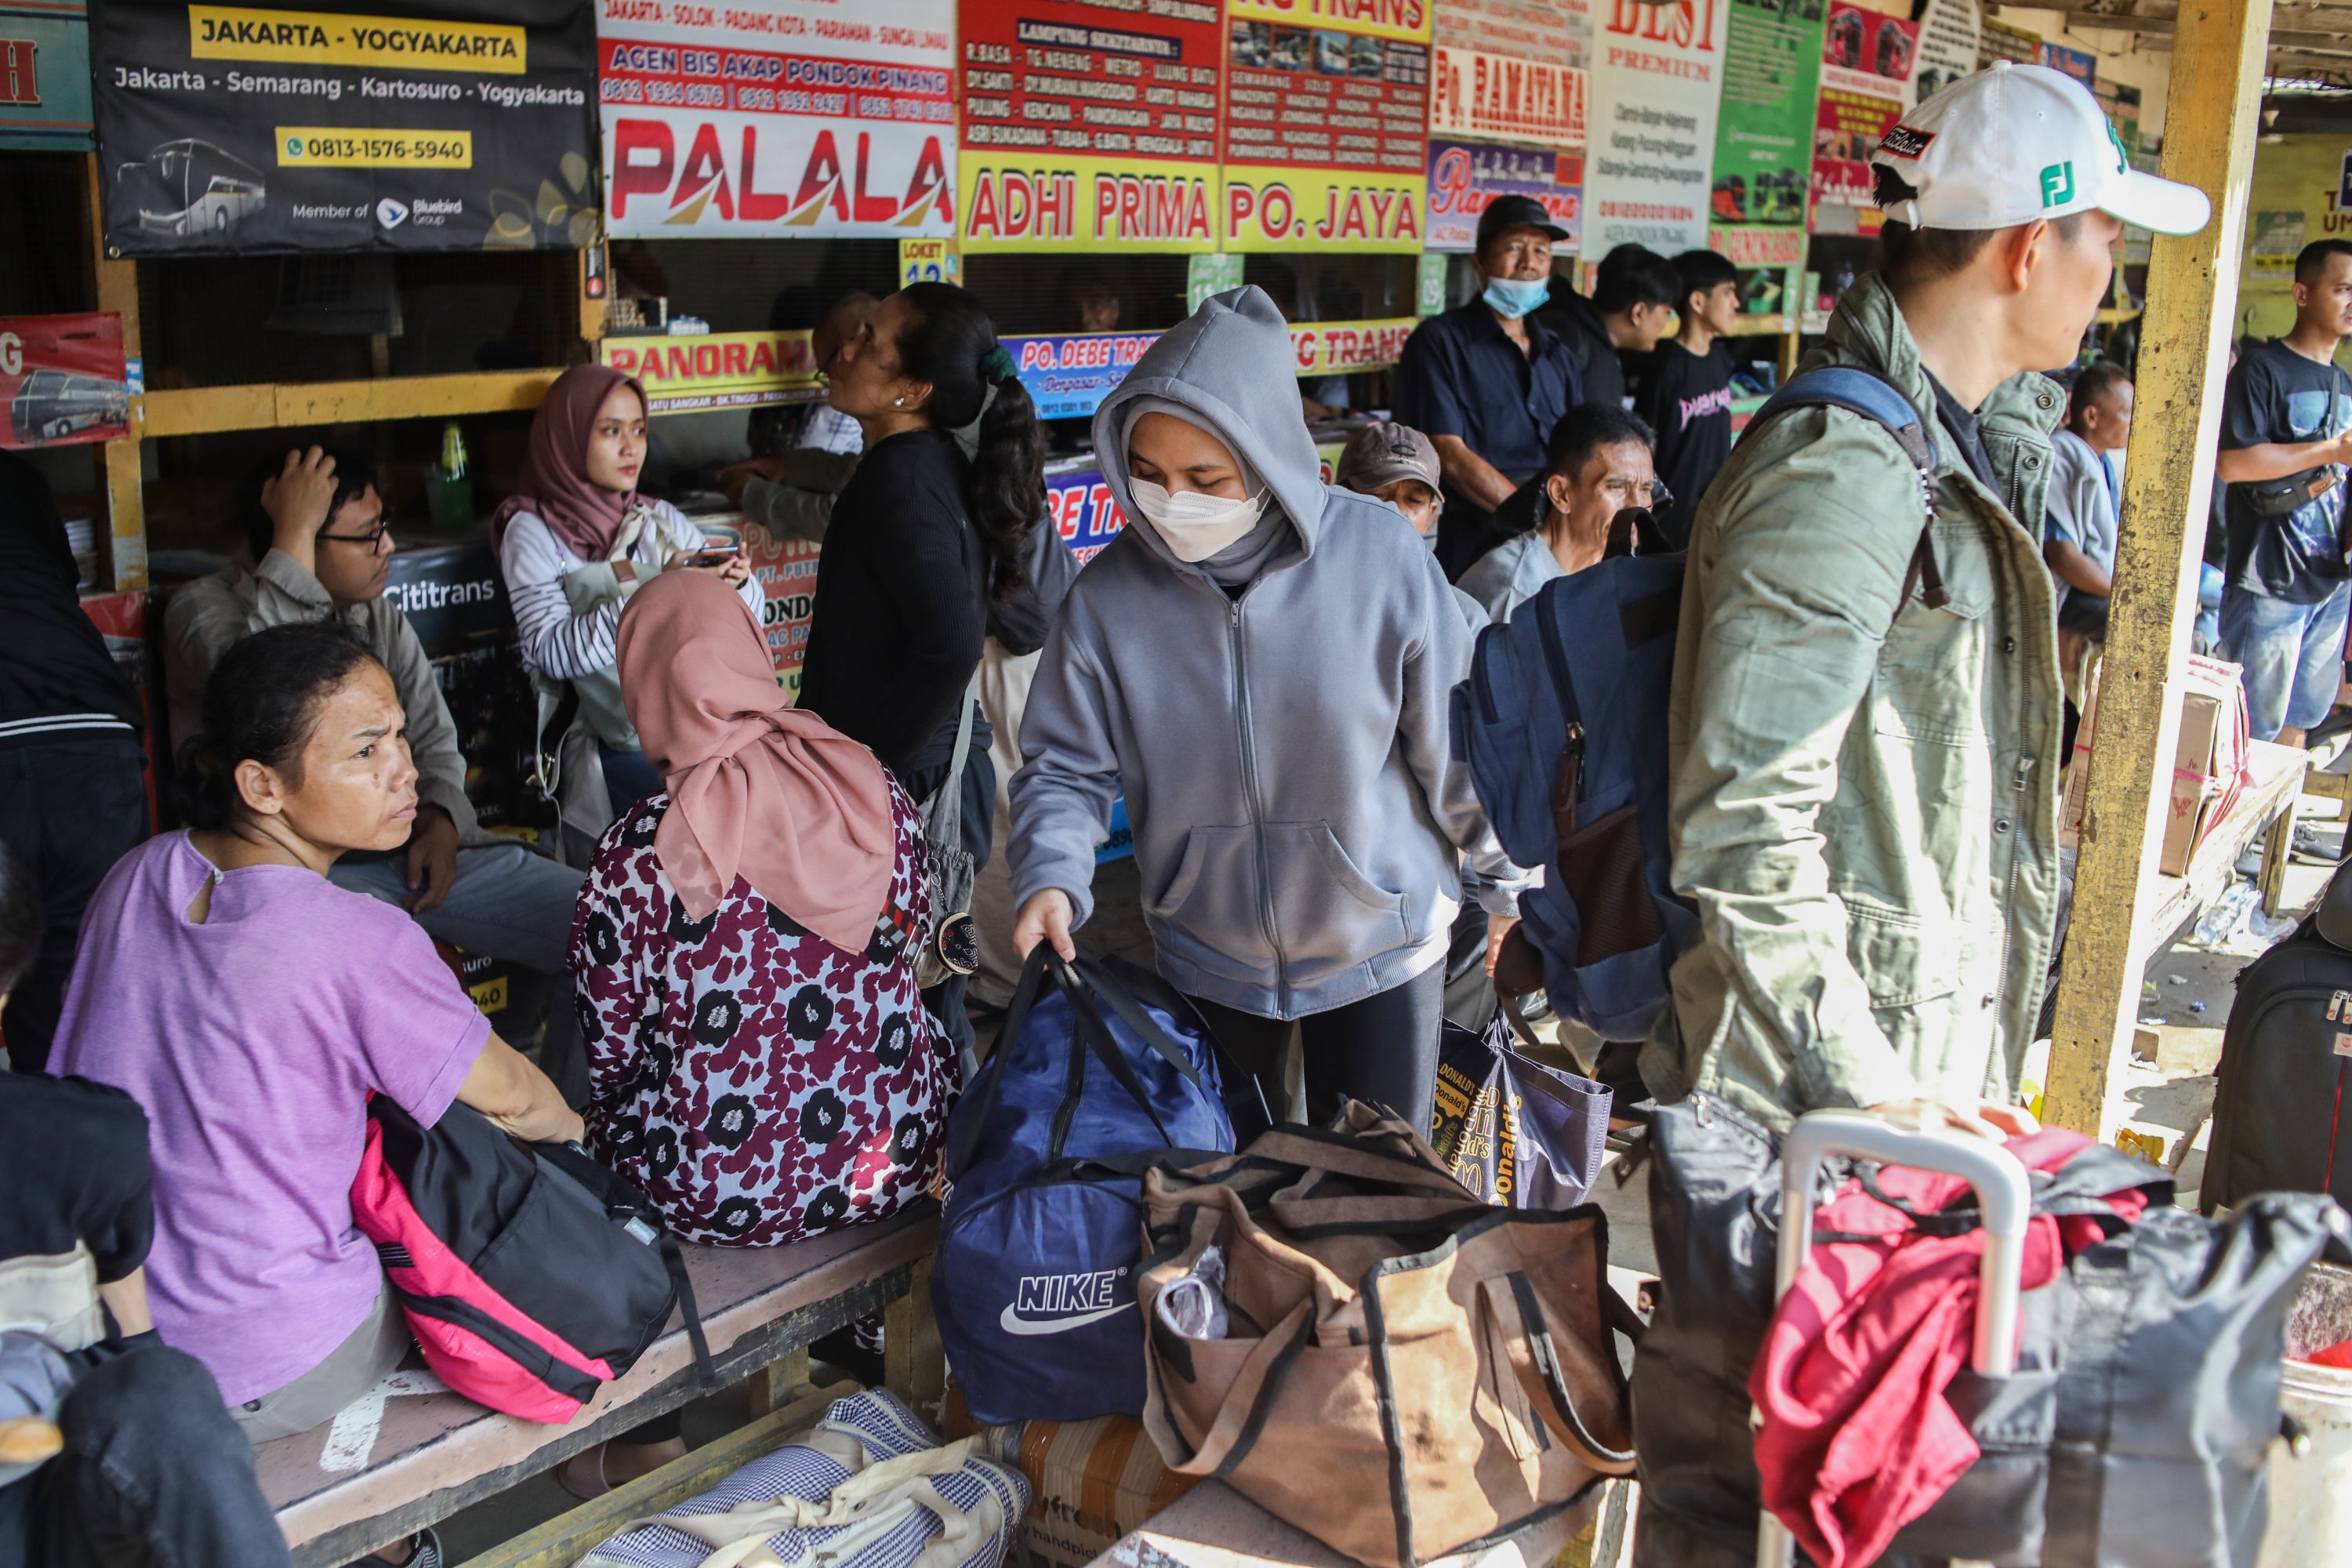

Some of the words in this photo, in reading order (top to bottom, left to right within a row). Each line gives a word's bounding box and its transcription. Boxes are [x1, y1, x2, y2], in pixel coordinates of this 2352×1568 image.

[201, 19, 329, 48] JAKARTA
[350, 28, 518, 59] YOGYAKARTA
[610, 44, 678, 74] AGEN
[682, 49, 720, 77] BIS
[722, 53, 784, 81] AKAP
[786, 57, 876, 89] PONDOK
[876, 66, 948, 96] PINANG
[1607, 46, 1711, 83] PREMIUM
[114, 66, 206, 92] Jakarta
[227, 71, 342, 101] Semarang
[361, 78, 462, 102] Kartosuro
[478, 82, 586, 107] Yogyakarta
[308, 138, 465, 160] 0813-1576-5940
[610, 118, 953, 226] PALALA
[292, 203, 352, 219] Member
[354, 202, 370, 219] of
[412, 199, 463, 215] Bluebird
[966, 167, 1076, 241] ADHI
[1094, 172, 1213, 241] PRIMA
[1227, 182, 1306, 242] PO.
[1314, 185, 1420, 242] JAYA
[903, 241, 942, 259] LOKET
[609, 336, 816, 381] PANORAM
[1021, 340, 1058, 372] PO.
[1060, 339, 1112, 371] DEBE
[1113, 336, 1163, 367] TRA
[1323, 325, 1413, 368] TRANS
[382, 579, 495, 612] Cititrans
[1438, 1062, 1475, 1096] DONALD'S
[1017, 1269, 1117, 1312] NIKE
